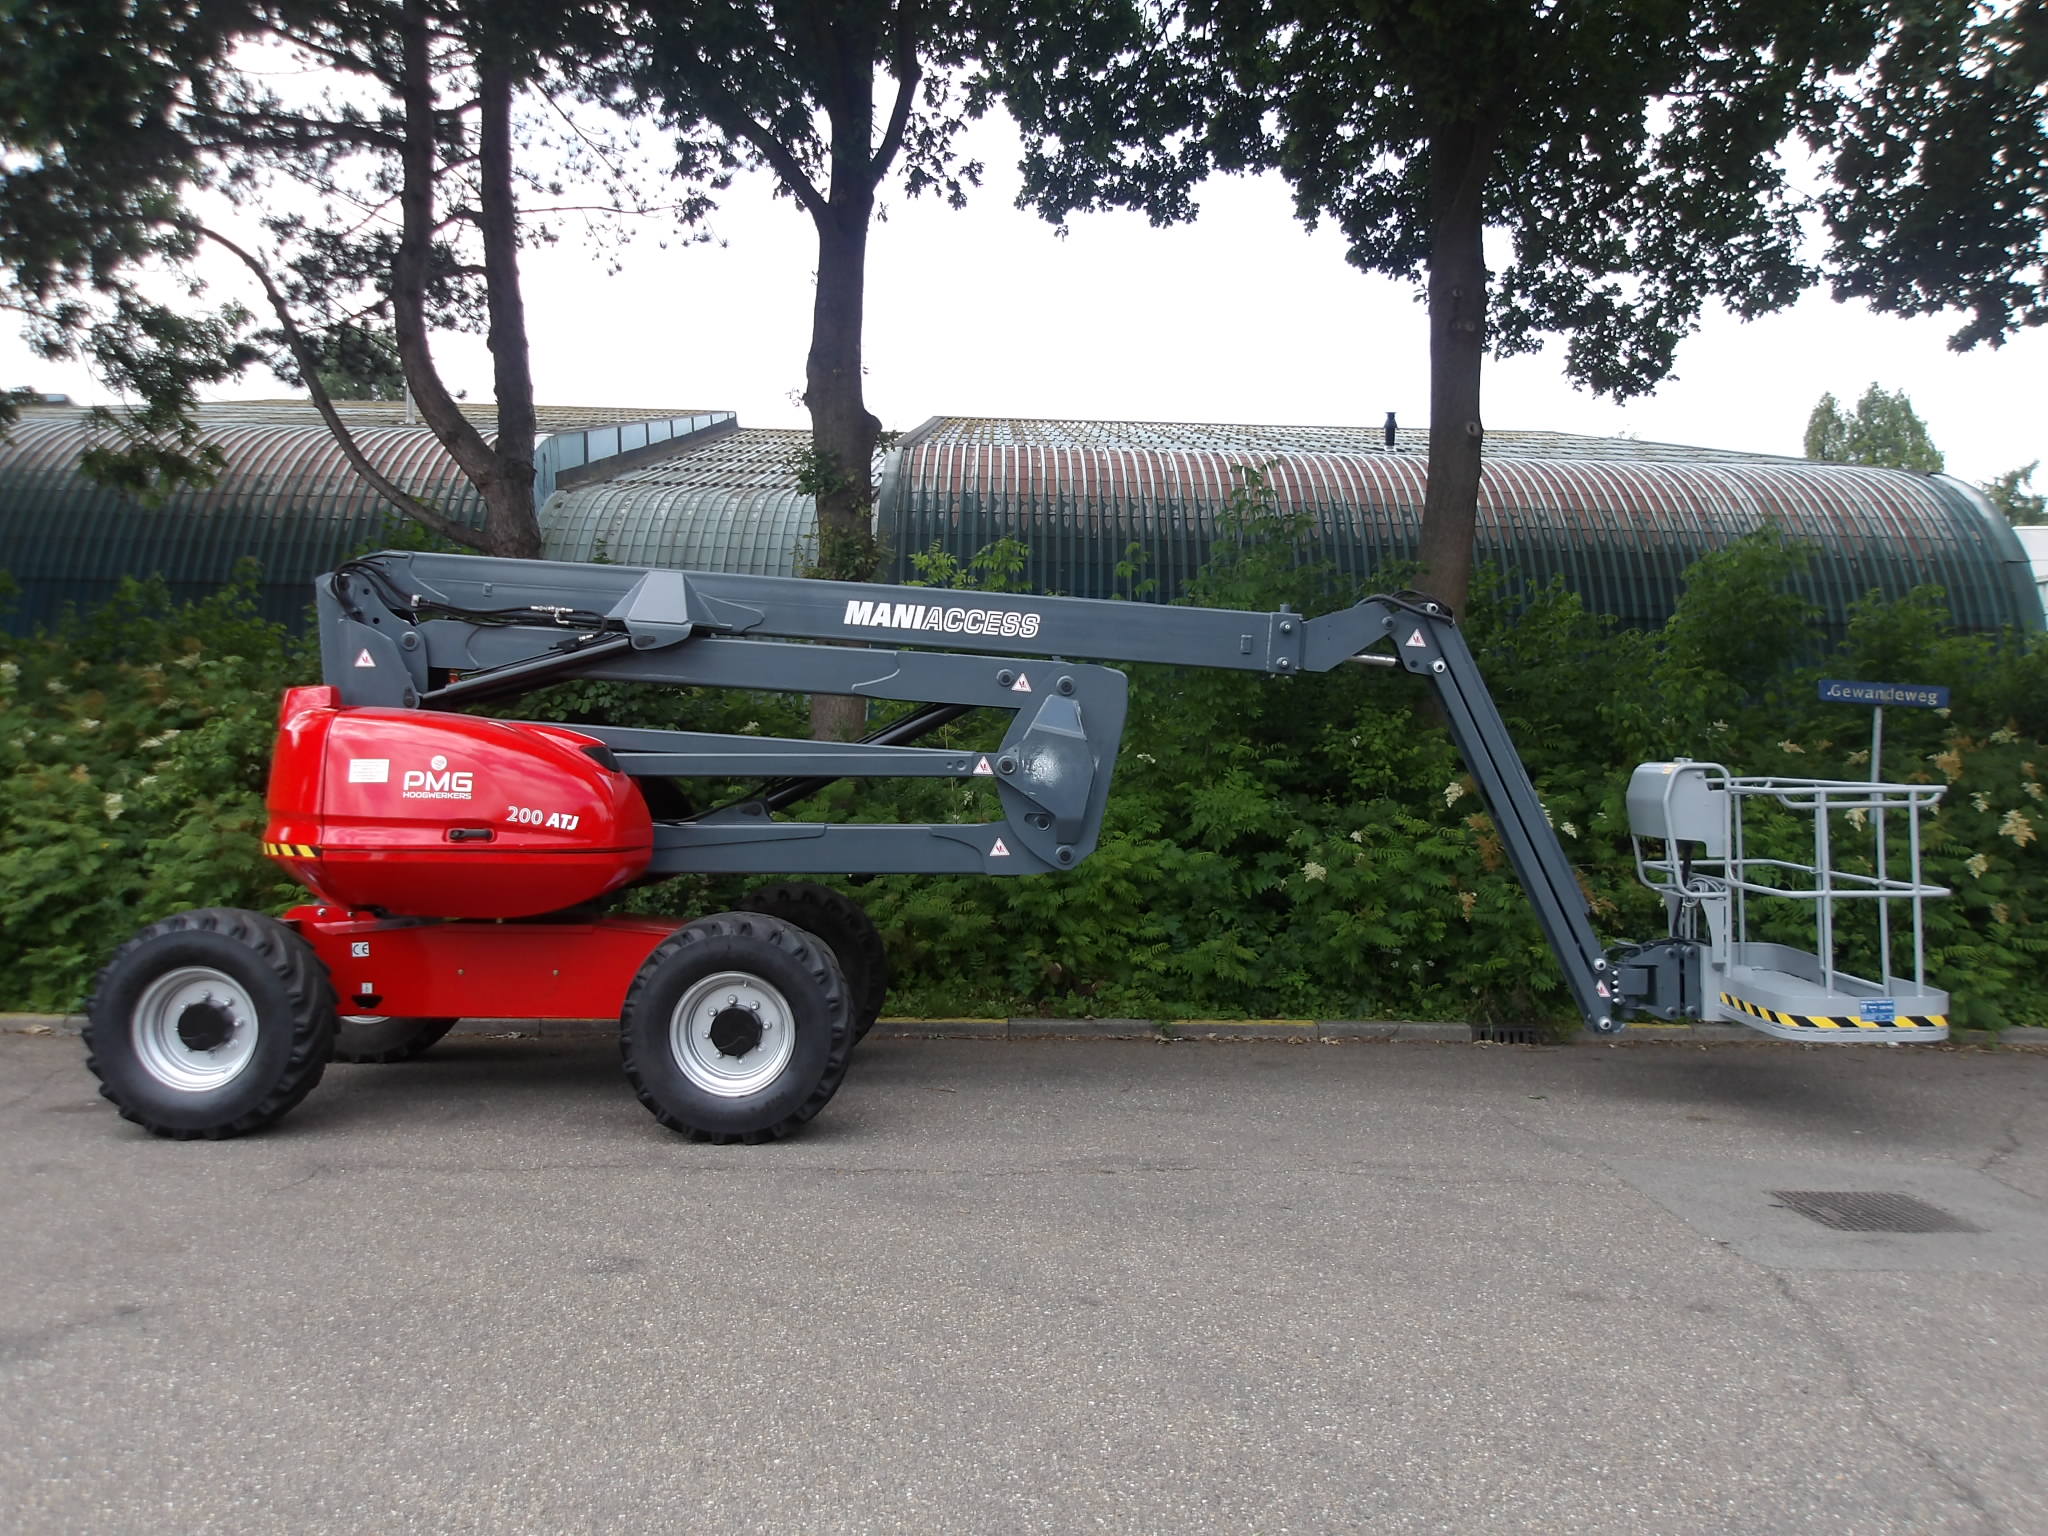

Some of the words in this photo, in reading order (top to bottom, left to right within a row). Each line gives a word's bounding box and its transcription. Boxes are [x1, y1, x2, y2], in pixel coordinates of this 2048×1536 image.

[843, 600, 1041, 639] MANIACCESS
[1830, 684, 1938, 705] Gewandeweg
[403, 770, 474, 792] PMG
[402, 791, 473, 800] HOOGWERKERS
[505, 805, 544, 825] 200
[545, 812, 580, 830] ATJ
[352, 943, 369, 955] CE
